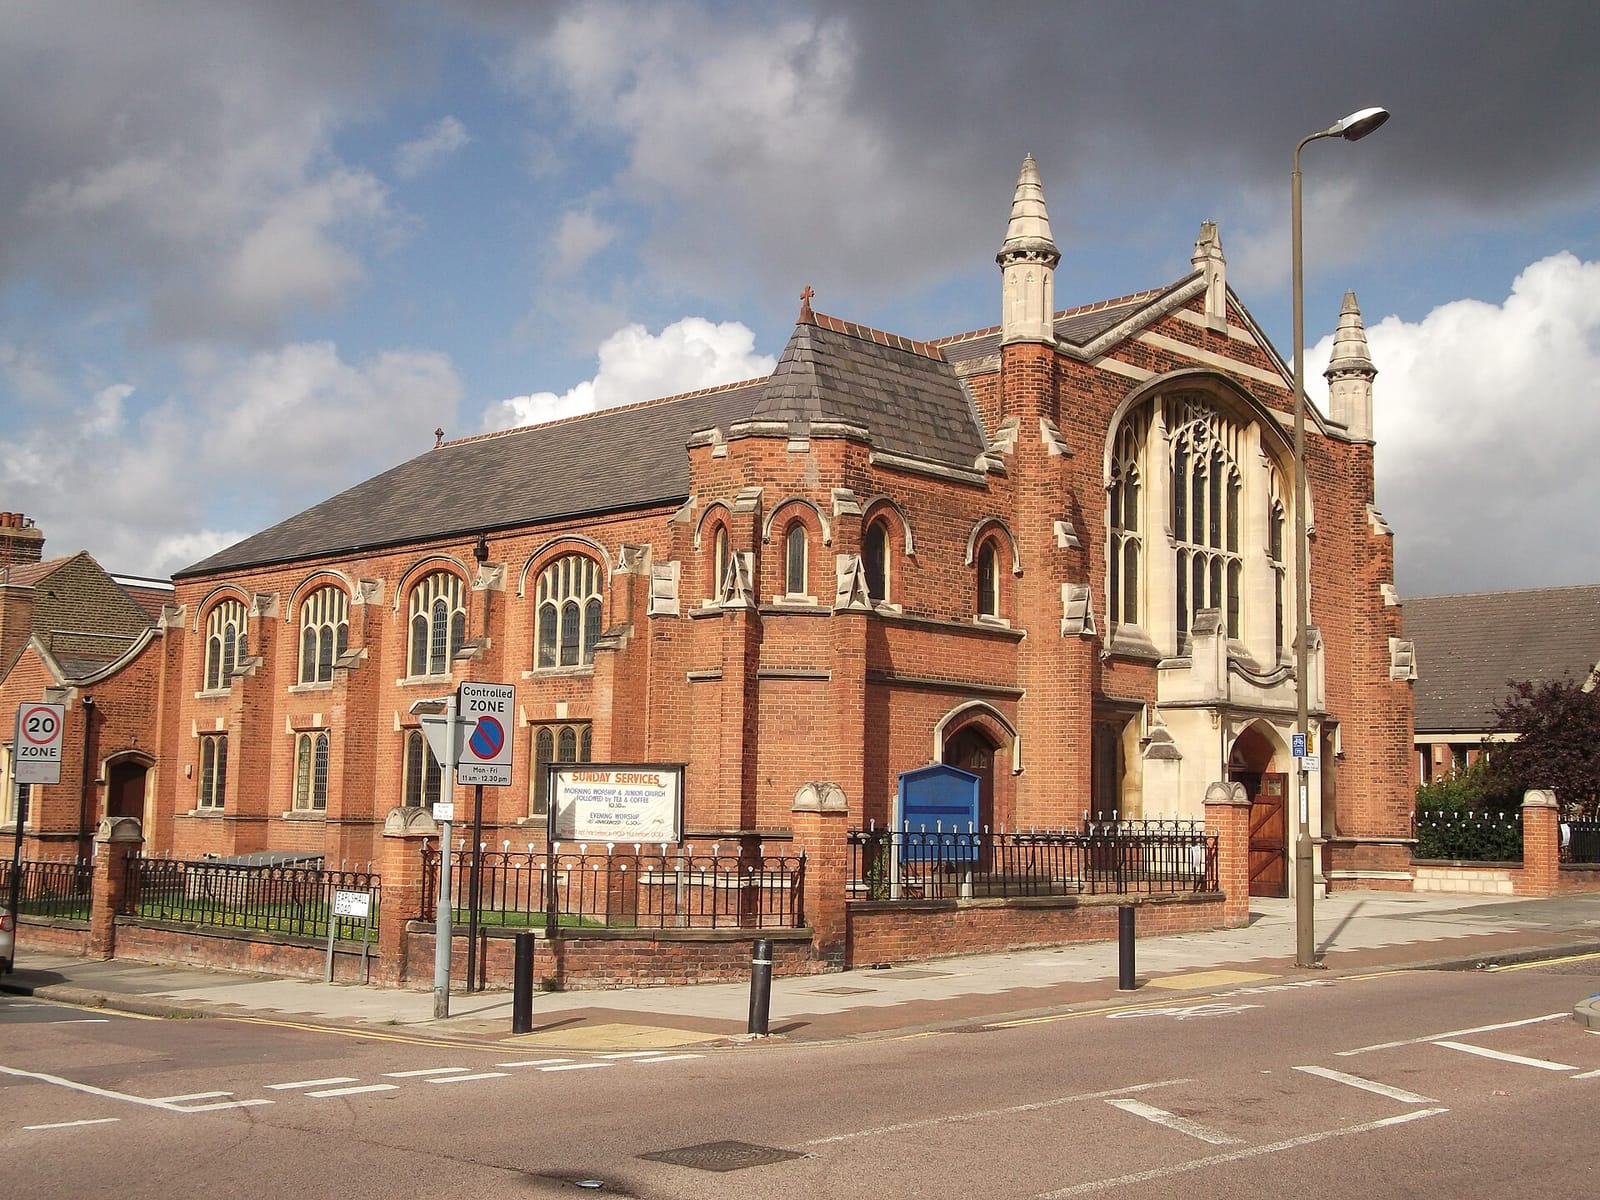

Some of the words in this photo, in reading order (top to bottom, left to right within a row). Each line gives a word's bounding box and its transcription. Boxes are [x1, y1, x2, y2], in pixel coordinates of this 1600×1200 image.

[463, 686, 513, 699] Controlled
[470, 700, 505, 713] ZONE
[28, 717, 55, 733] 20
[21, 746, 57, 757] ZONE
[571, 771, 612, 783] SUNDAY
[614, 774, 660, 785] SERVICES
[564, 787, 592, 795] MORNING
[645, 790, 666, 798] CHURCH
